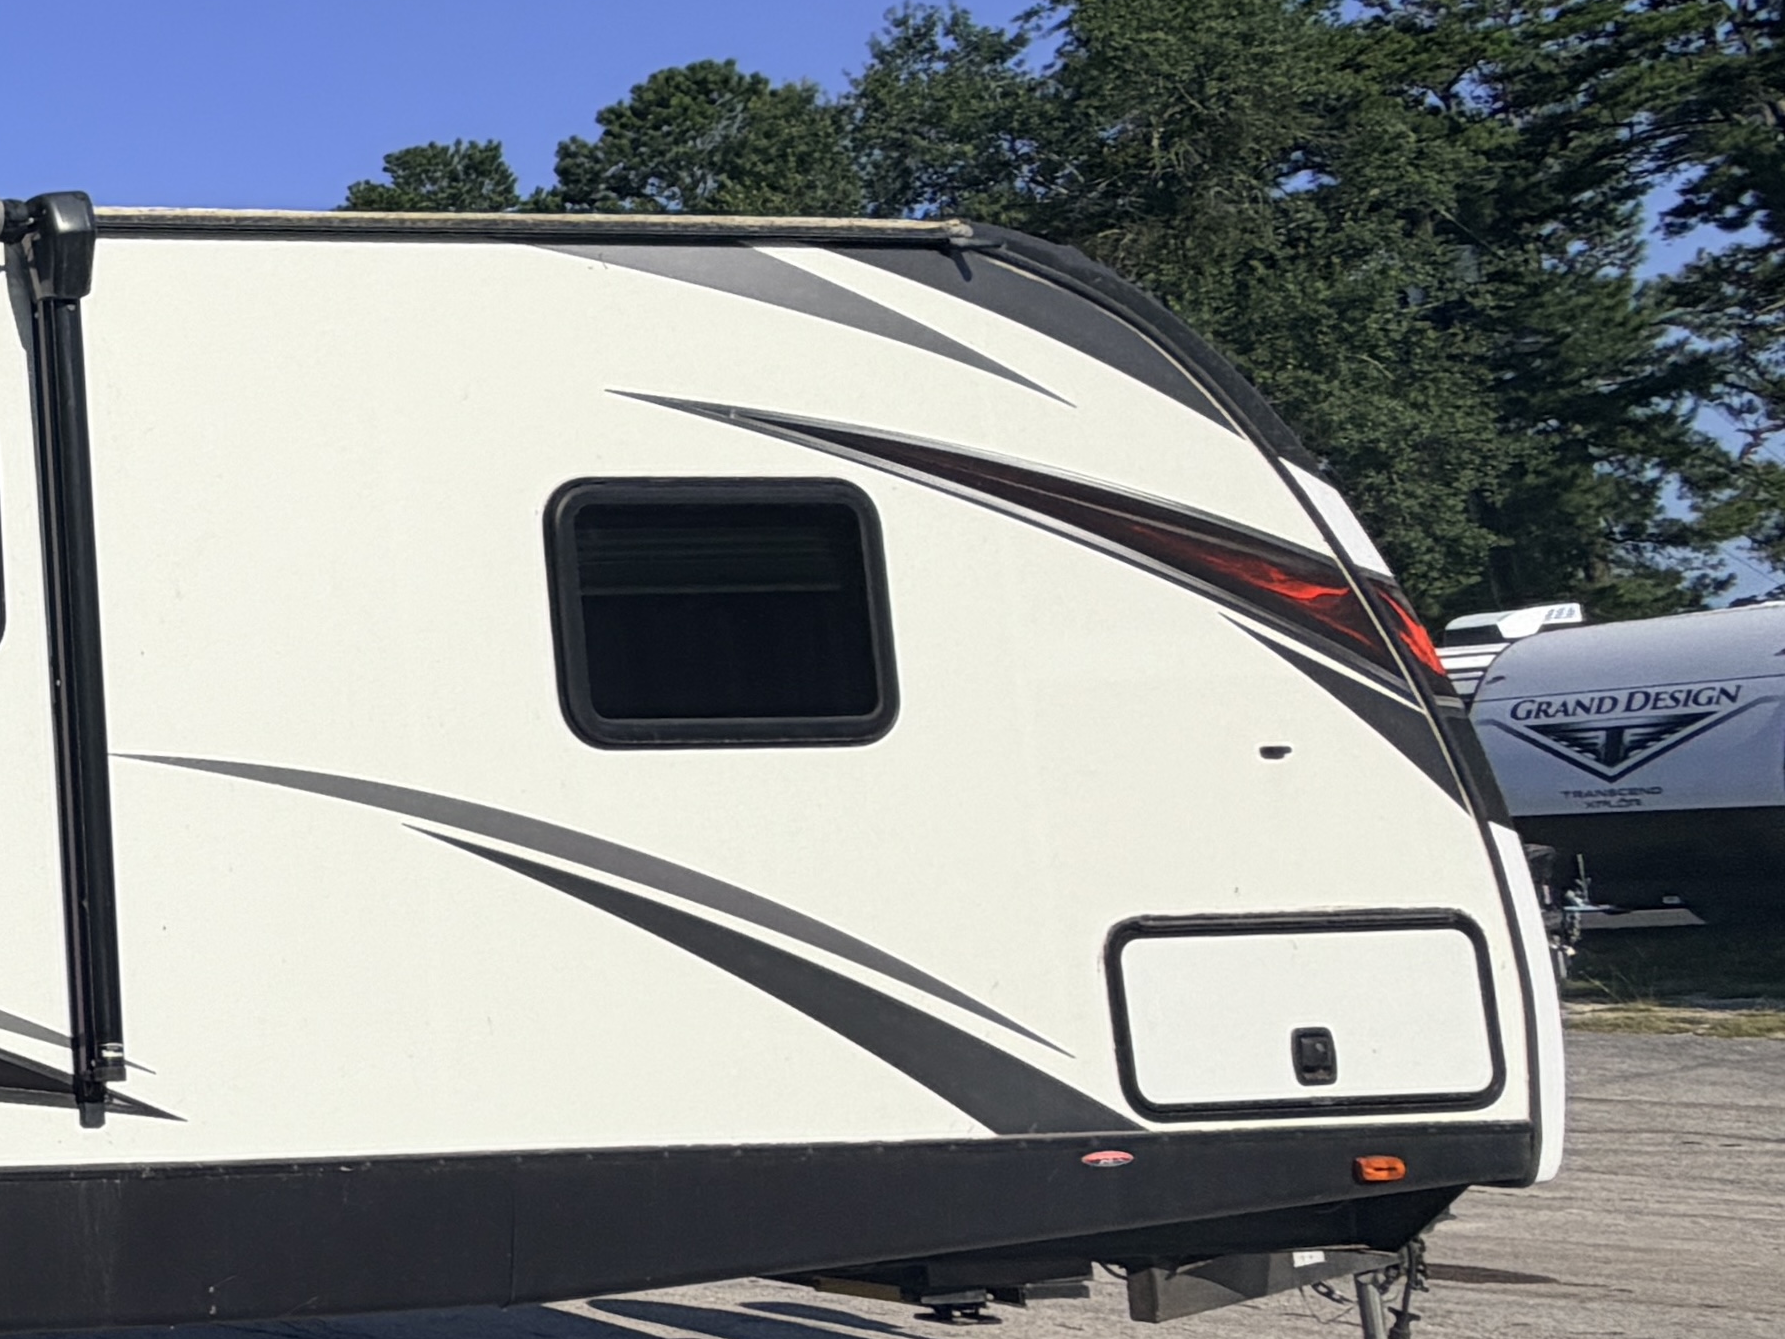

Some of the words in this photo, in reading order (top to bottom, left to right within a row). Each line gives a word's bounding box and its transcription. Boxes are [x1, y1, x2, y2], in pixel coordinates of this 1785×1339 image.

[1510, 695, 1618, 721] GRAND
[1624, 684, 1742, 713] DESIGN
[1560, 786, 1664, 799] TRANSCEND
